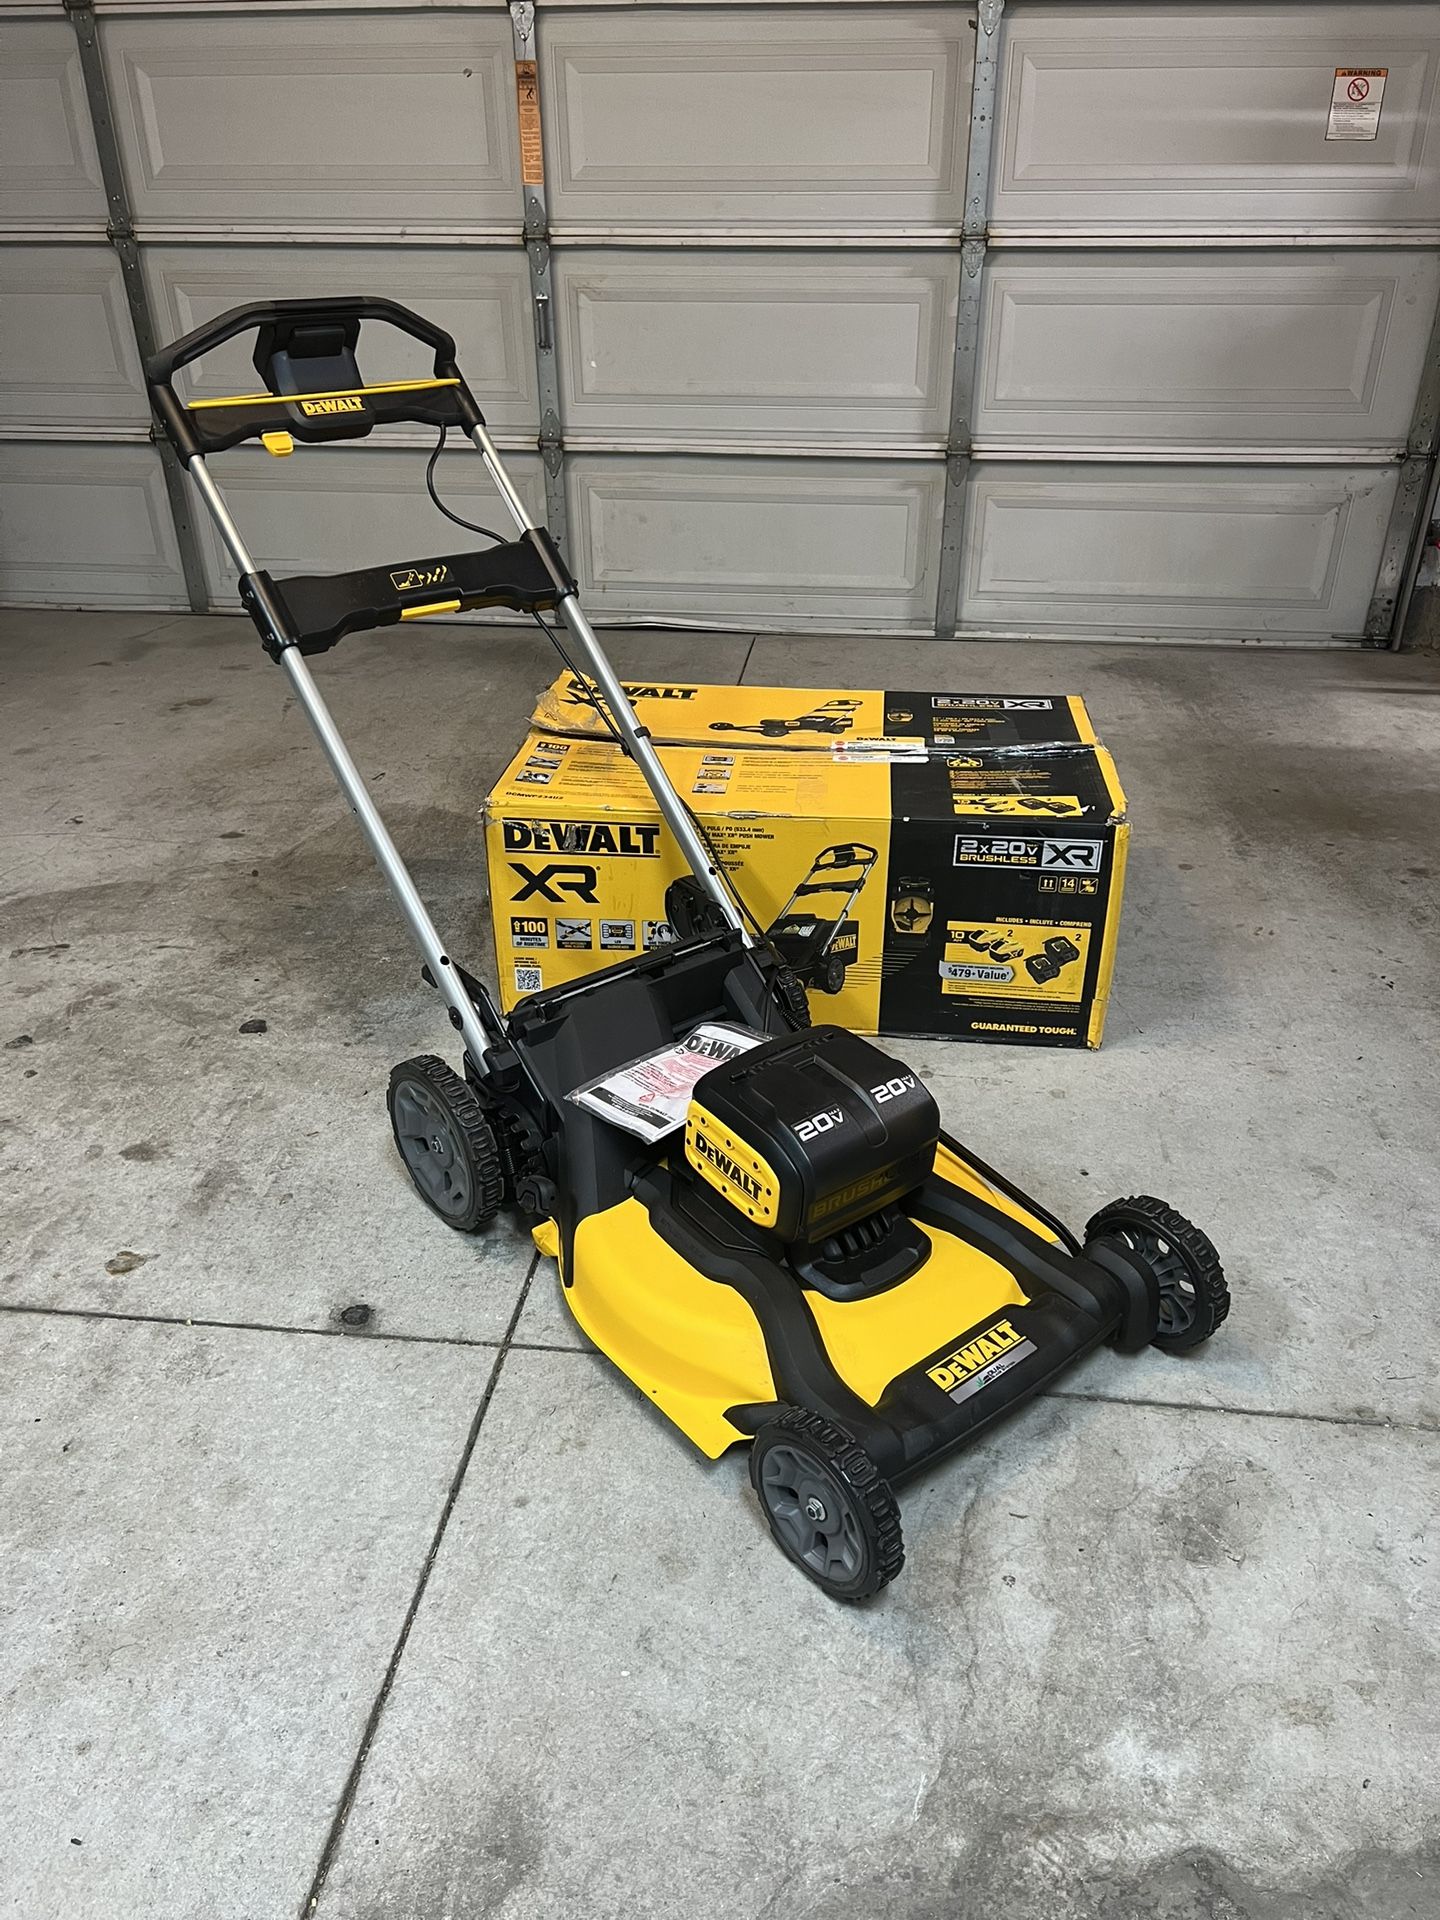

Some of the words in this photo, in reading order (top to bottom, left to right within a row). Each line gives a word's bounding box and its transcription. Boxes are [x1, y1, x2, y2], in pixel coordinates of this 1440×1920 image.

[302, 397, 364, 414] DEWALT
[502, 821, 660, 854] DEWALT
[959, 854, 1037, 864] BRUSHLESS
[1044, 844, 1095, 867] XR
[507, 863, 600, 904] XR
[1062, 878, 1075, 887] 14
[521, 921, 546, 933] 100
[996, 916, 1023, 924] INCLUDES
[1059, 920, 1093, 928] COMPREND
[951, 931, 965, 939] 10
[1007, 929, 1014, 937] 2
[1075, 933, 1082, 942] 2
[971, 1022, 1037, 1033] GUARANTEED
[685, 1035, 741, 1060] DEWA
[870, 1077, 916, 1104] 20V
[793, 1112, 844, 1142] 20V
[696, 1132, 763, 1201] DEWALT
[927, 1321, 1021, 1391] DEWALT
